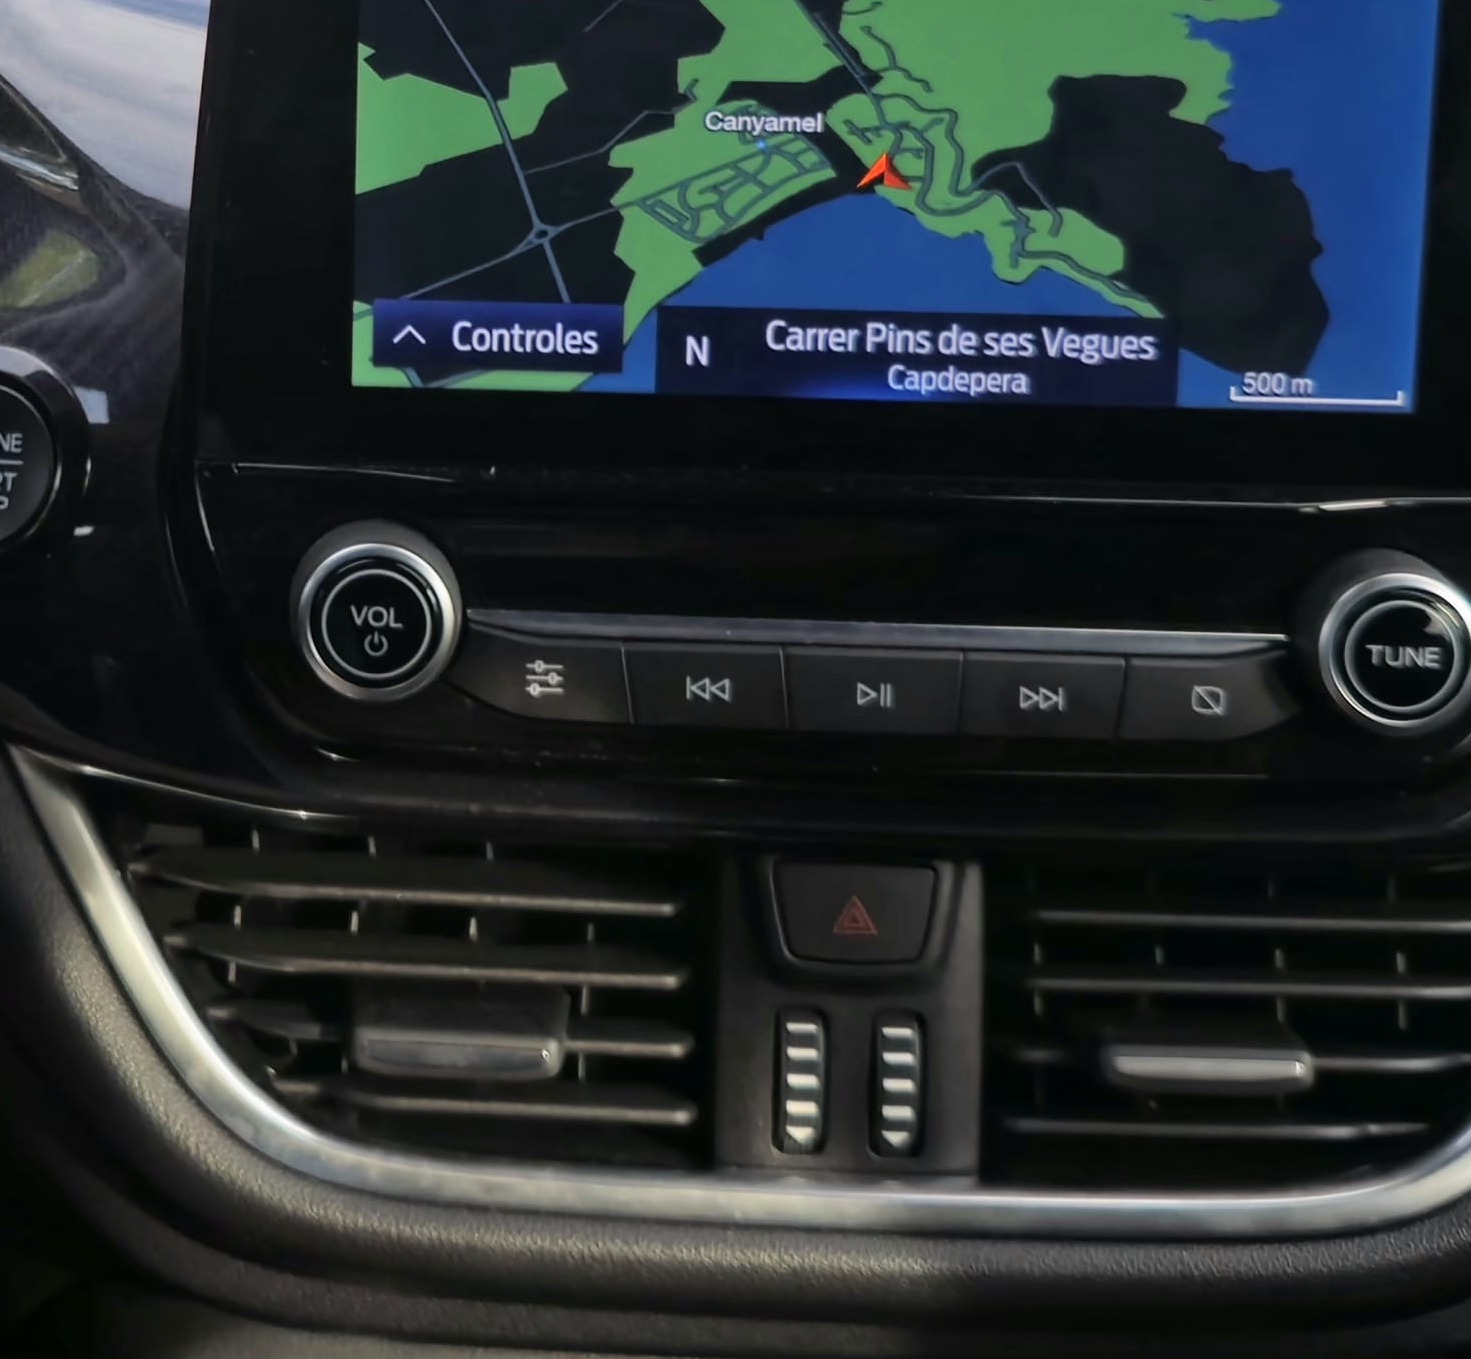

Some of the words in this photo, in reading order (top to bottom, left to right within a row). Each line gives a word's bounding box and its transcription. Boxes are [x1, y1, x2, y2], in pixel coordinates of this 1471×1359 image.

[705, 111, 824, 135] Canyamel
[452, 321, 598, 355] Controles
[685, 336, 710, 367] N
[765, 319, 860, 352] Carrer
[865, 322, 931, 356] Pins
[938, 324, 978, 356] de
[983, 329, 1035, 357] ses
[1041, 327, 1156, 365] Vegues
[888, 364, 1030, 396] Capdepera
[1243, 372, 1285, 395] 500
[1291, 377, 1314, 395] m
[350, 604, 404, 629] VOL
[1365, 644, 1442, 670] TUNE
